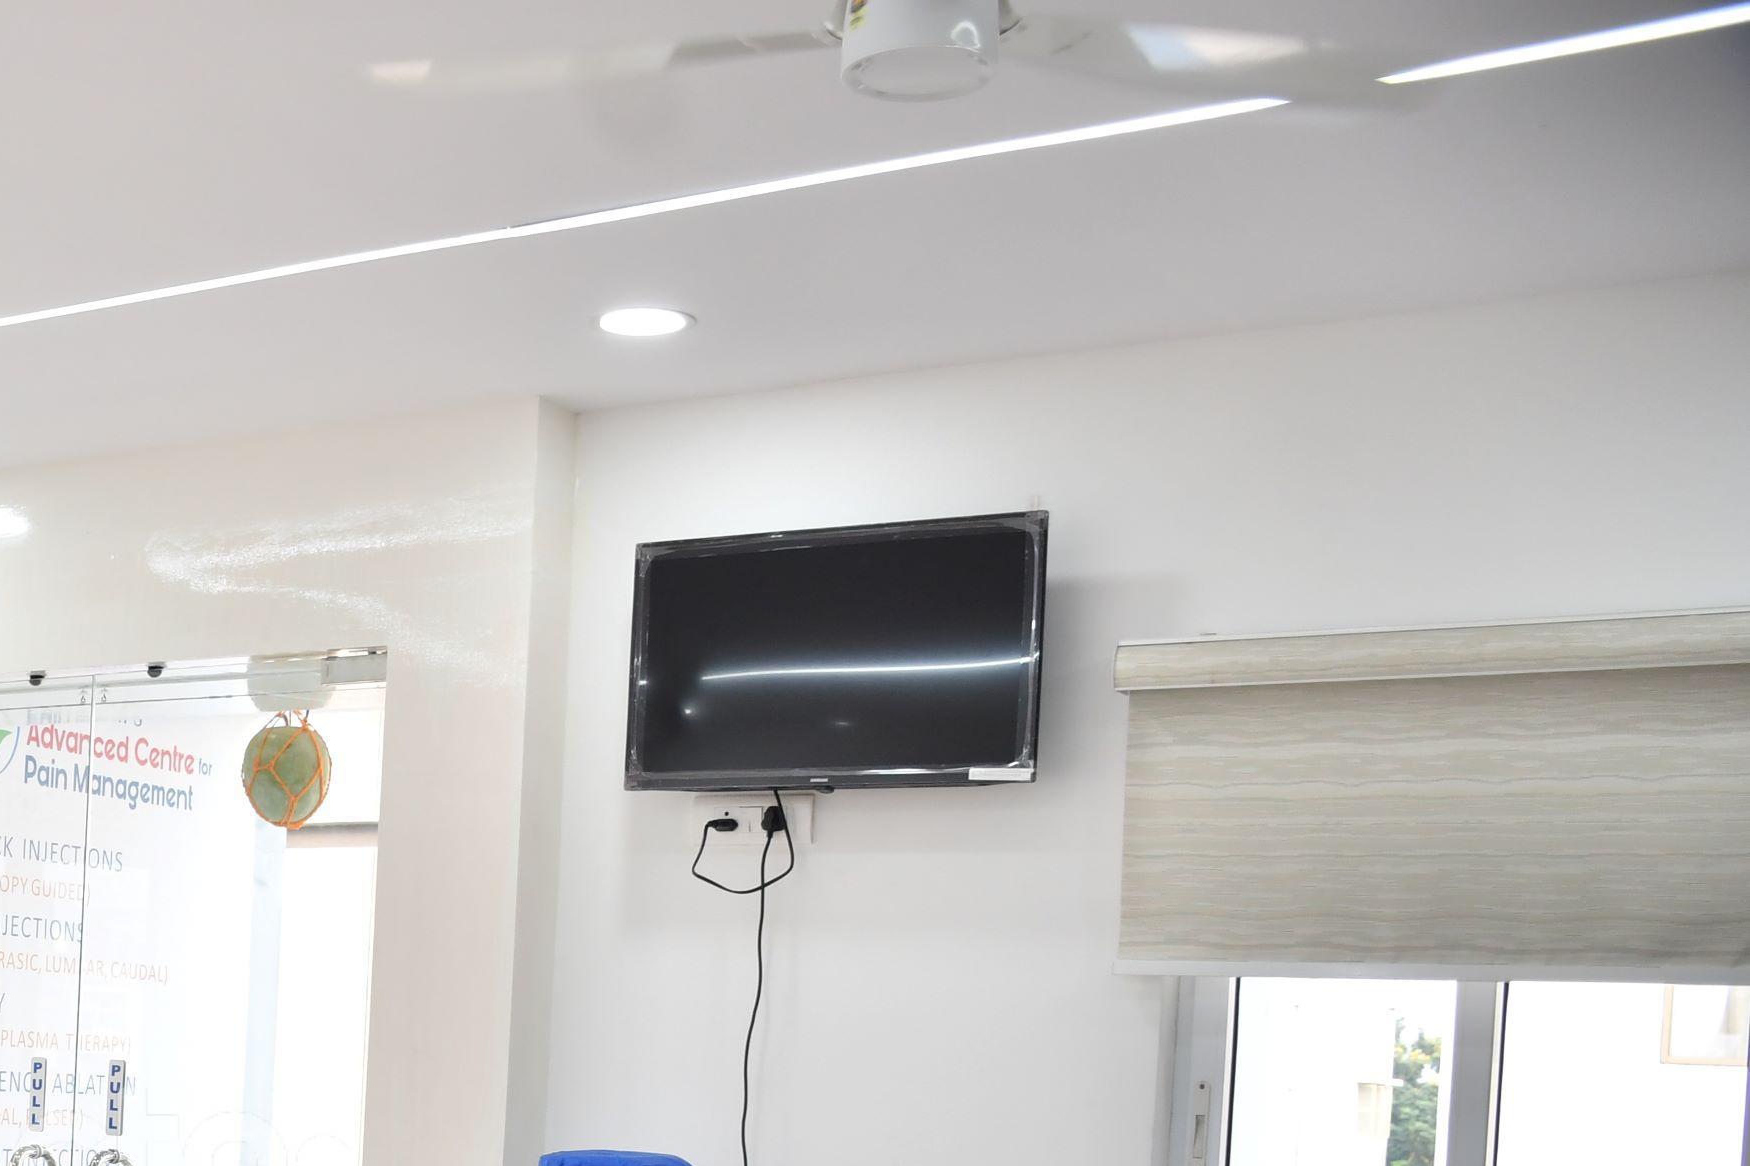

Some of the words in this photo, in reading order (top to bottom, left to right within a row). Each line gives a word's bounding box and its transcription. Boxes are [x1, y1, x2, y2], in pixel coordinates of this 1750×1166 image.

[27, 724, 129, 763] Advanced
[135, 737, 195, 774] Centre
[198, 757, 213, 776] for
[24, 754, 68, 790] Pain
[73, 763, 194, 810] Management
[22, 838, 123, 872] INJECTONS
[45, 955, 107, 981] LUMAR,
[0, 1030, 59, 1049] PLASMA
[32, 1062, 43, 1125] PULL
[51, 1072, 137, 1096] ABLATN
[108, 1065, 122, 1129] PULL
